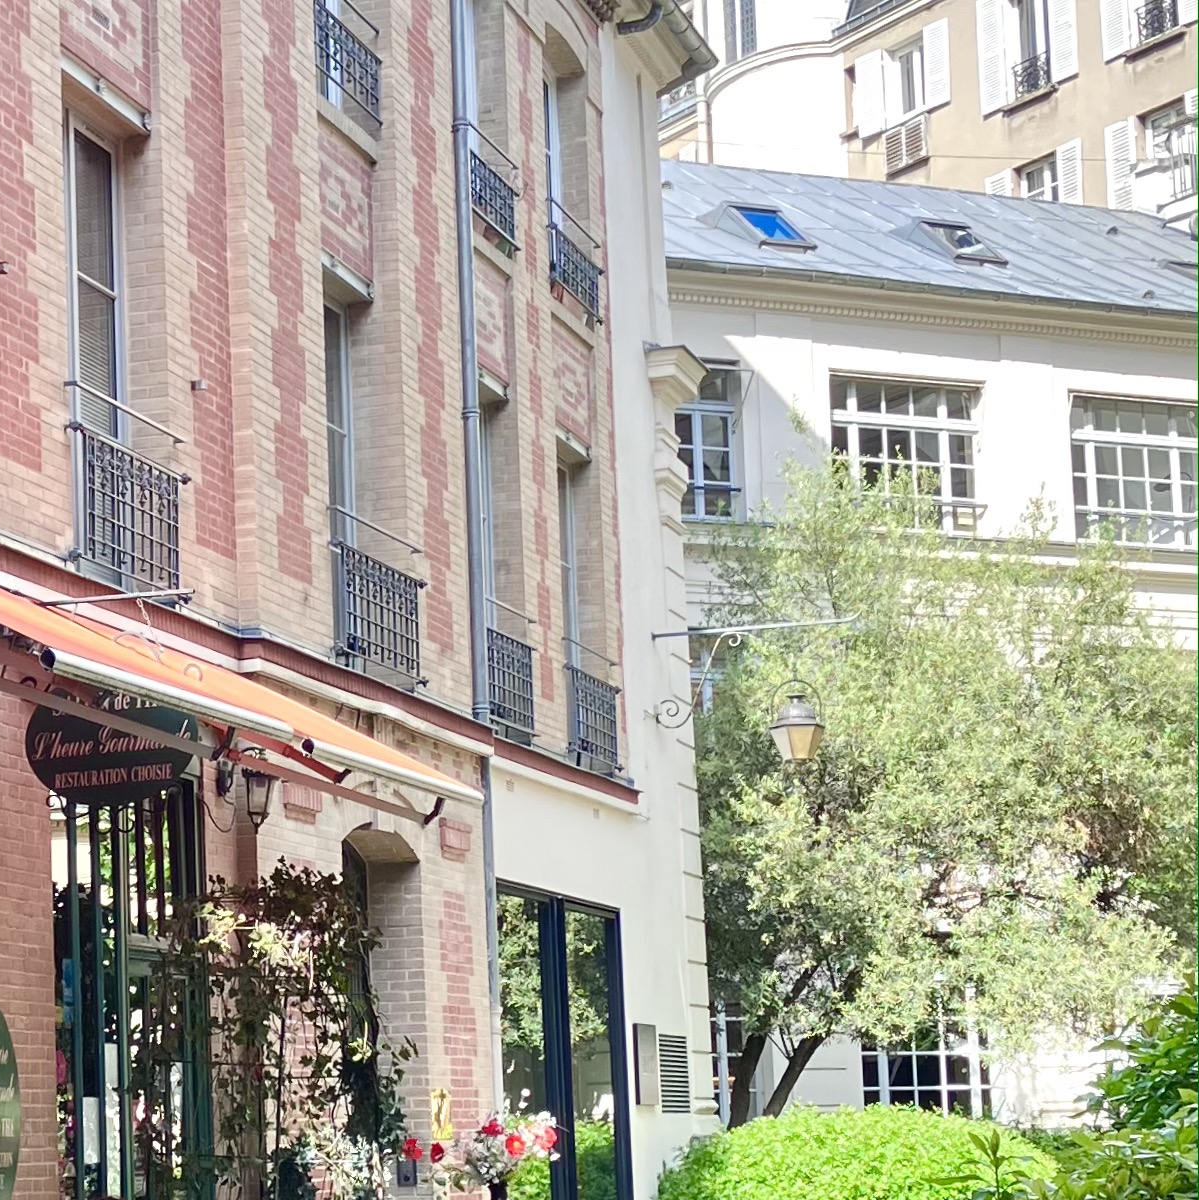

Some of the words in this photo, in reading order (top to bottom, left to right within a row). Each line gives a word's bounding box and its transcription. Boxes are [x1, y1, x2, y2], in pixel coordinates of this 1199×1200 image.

[114, 693, 131, 711] de
[32, 730, 95, 761] L'heure
[54, 767, 128, 789] RESTAURATION
[131, 763, 173, 782] CHOISIE
